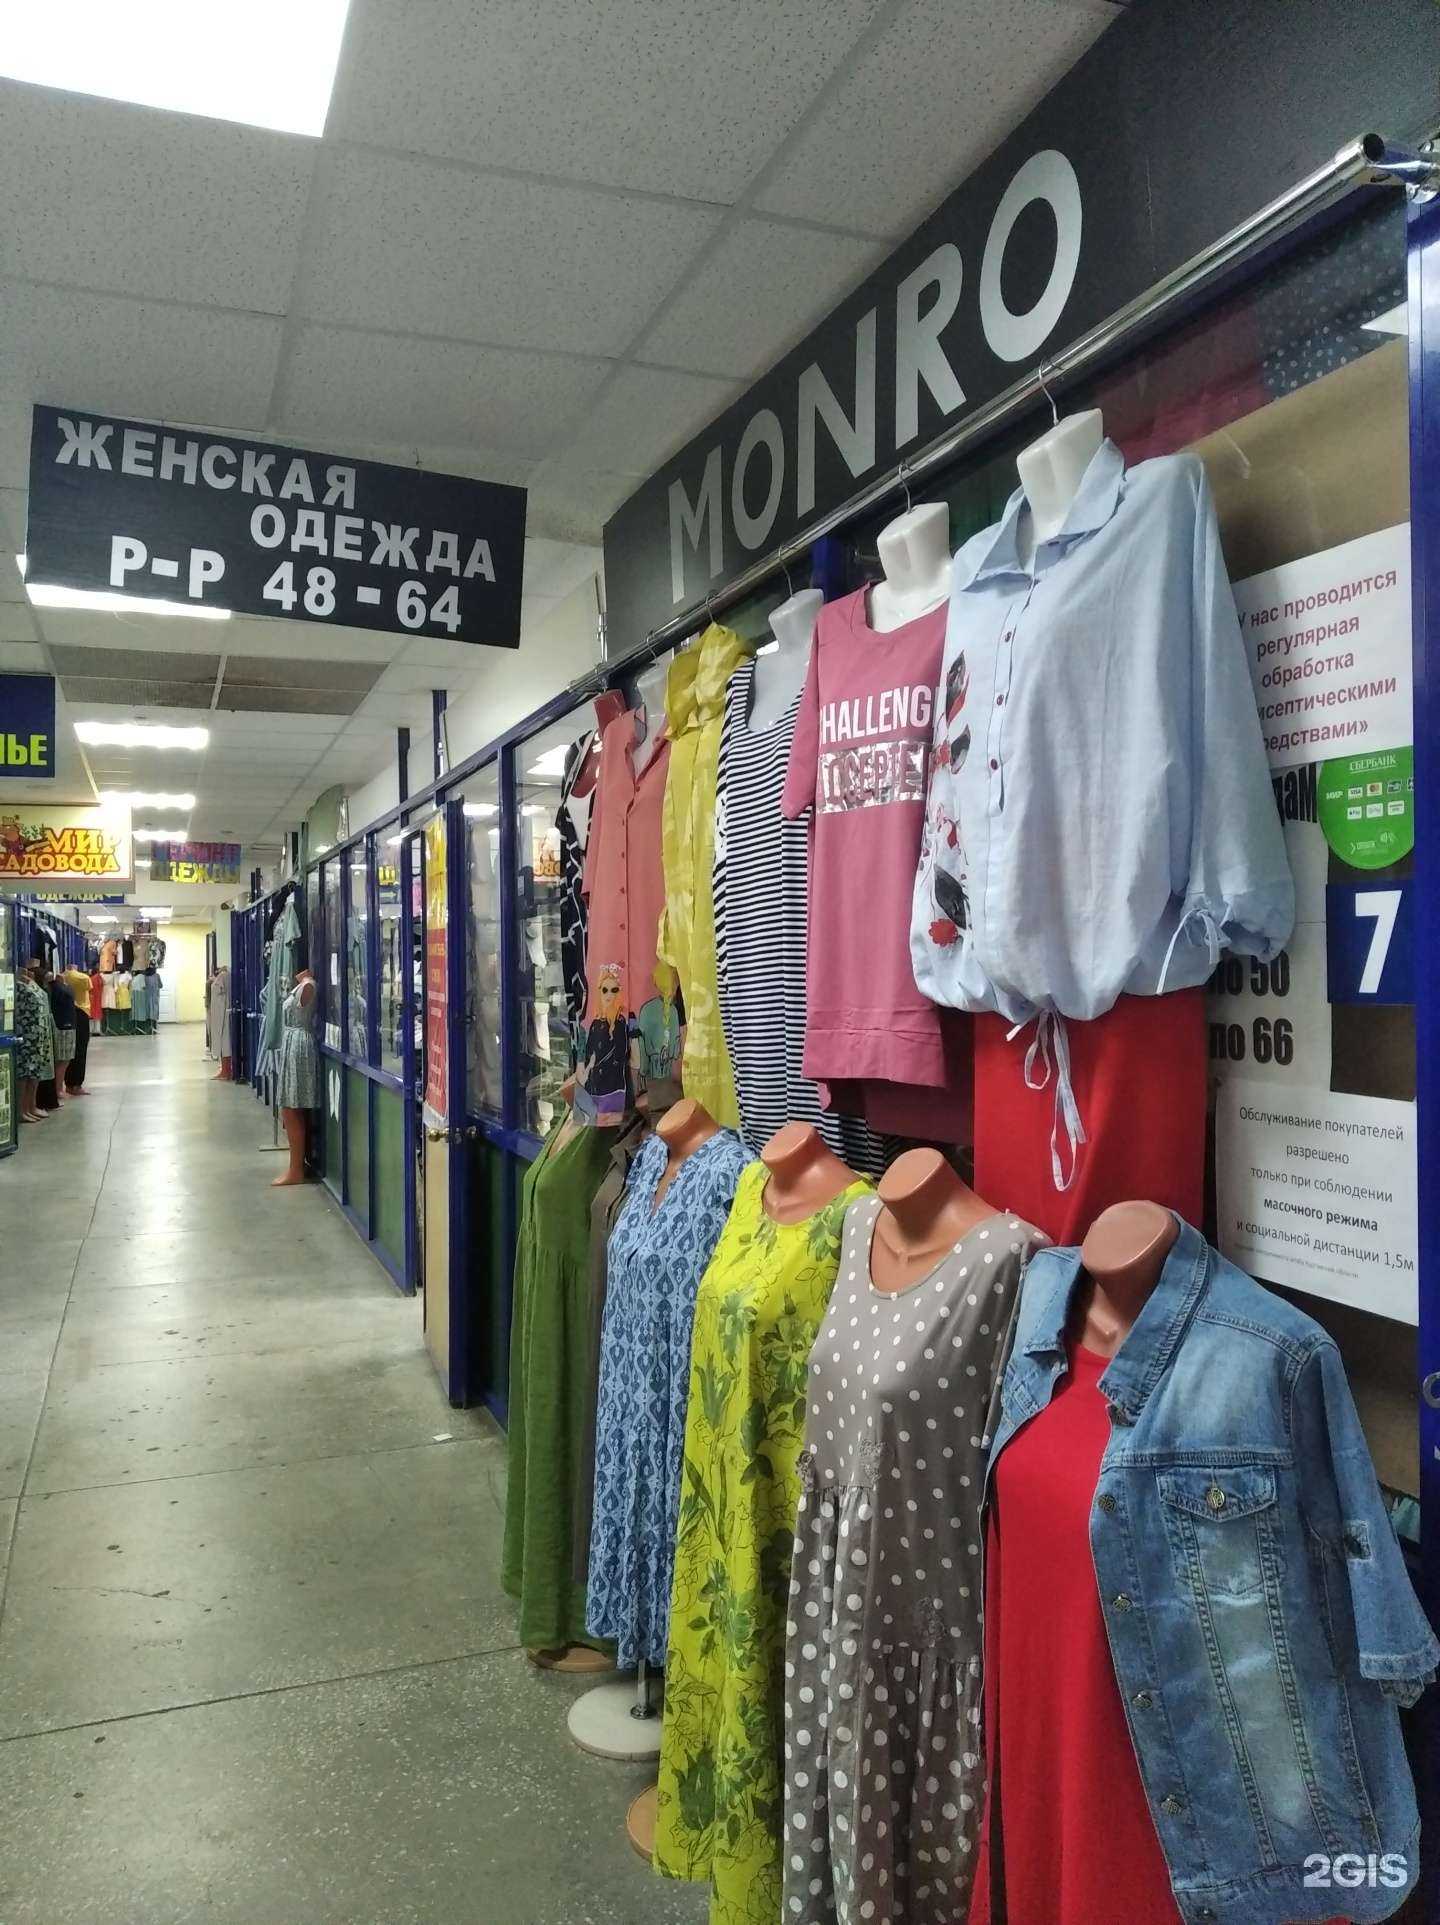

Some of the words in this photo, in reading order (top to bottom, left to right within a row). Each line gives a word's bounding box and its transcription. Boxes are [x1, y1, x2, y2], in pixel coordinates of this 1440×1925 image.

[668, 149, 1083, 604] MONRO
[55, 417, 356, 510] ЖЕНСКАЯ
[250, 504, 496, 582] ОДЕЖДА
[109, 535, 226, 598] Р-Р
[263, 561, 337, 617] 48
[396, 580, 462, 633] 64
[1251, 607, 1279, 627] нас
[1284, 570, 1397, 619] проводится
[1257, 616, 1360, 661] регулярная
[1262, 652, 1354, 688] обработка
[820, 685, 932, 745] HALLENG
[42, 828, 120, 854] МИР
[1355, 890, 1403, 994] 7
[1250, 949, 1290, 997] 50
[1209, 1023, 1245, 1061] по
[1252, 1016, 1293, 1065] 66
[1239, 1106, 1322, 1130] Обслуживание
[1325, 1119, 1404, 1141] покупателей
[1286, 1144, 1350, 1164] разрешено
[1251, 1167, 1288, 1184] только
[1291, 1174, 1311, 1190] при
[1314, 1178, 1393, 1203] соблюдении
[1264, 1198, 1323, 1220] масочного
[1326, 1211, 1378, 1231] режима
[1237, 1221, 1243, 1231] и
[1246, 1221, 1311, 1247] социальной
[1314, 1238, 1380, 1264] дистанции
[1384, 1251, 1415, 1271] 1,5м
